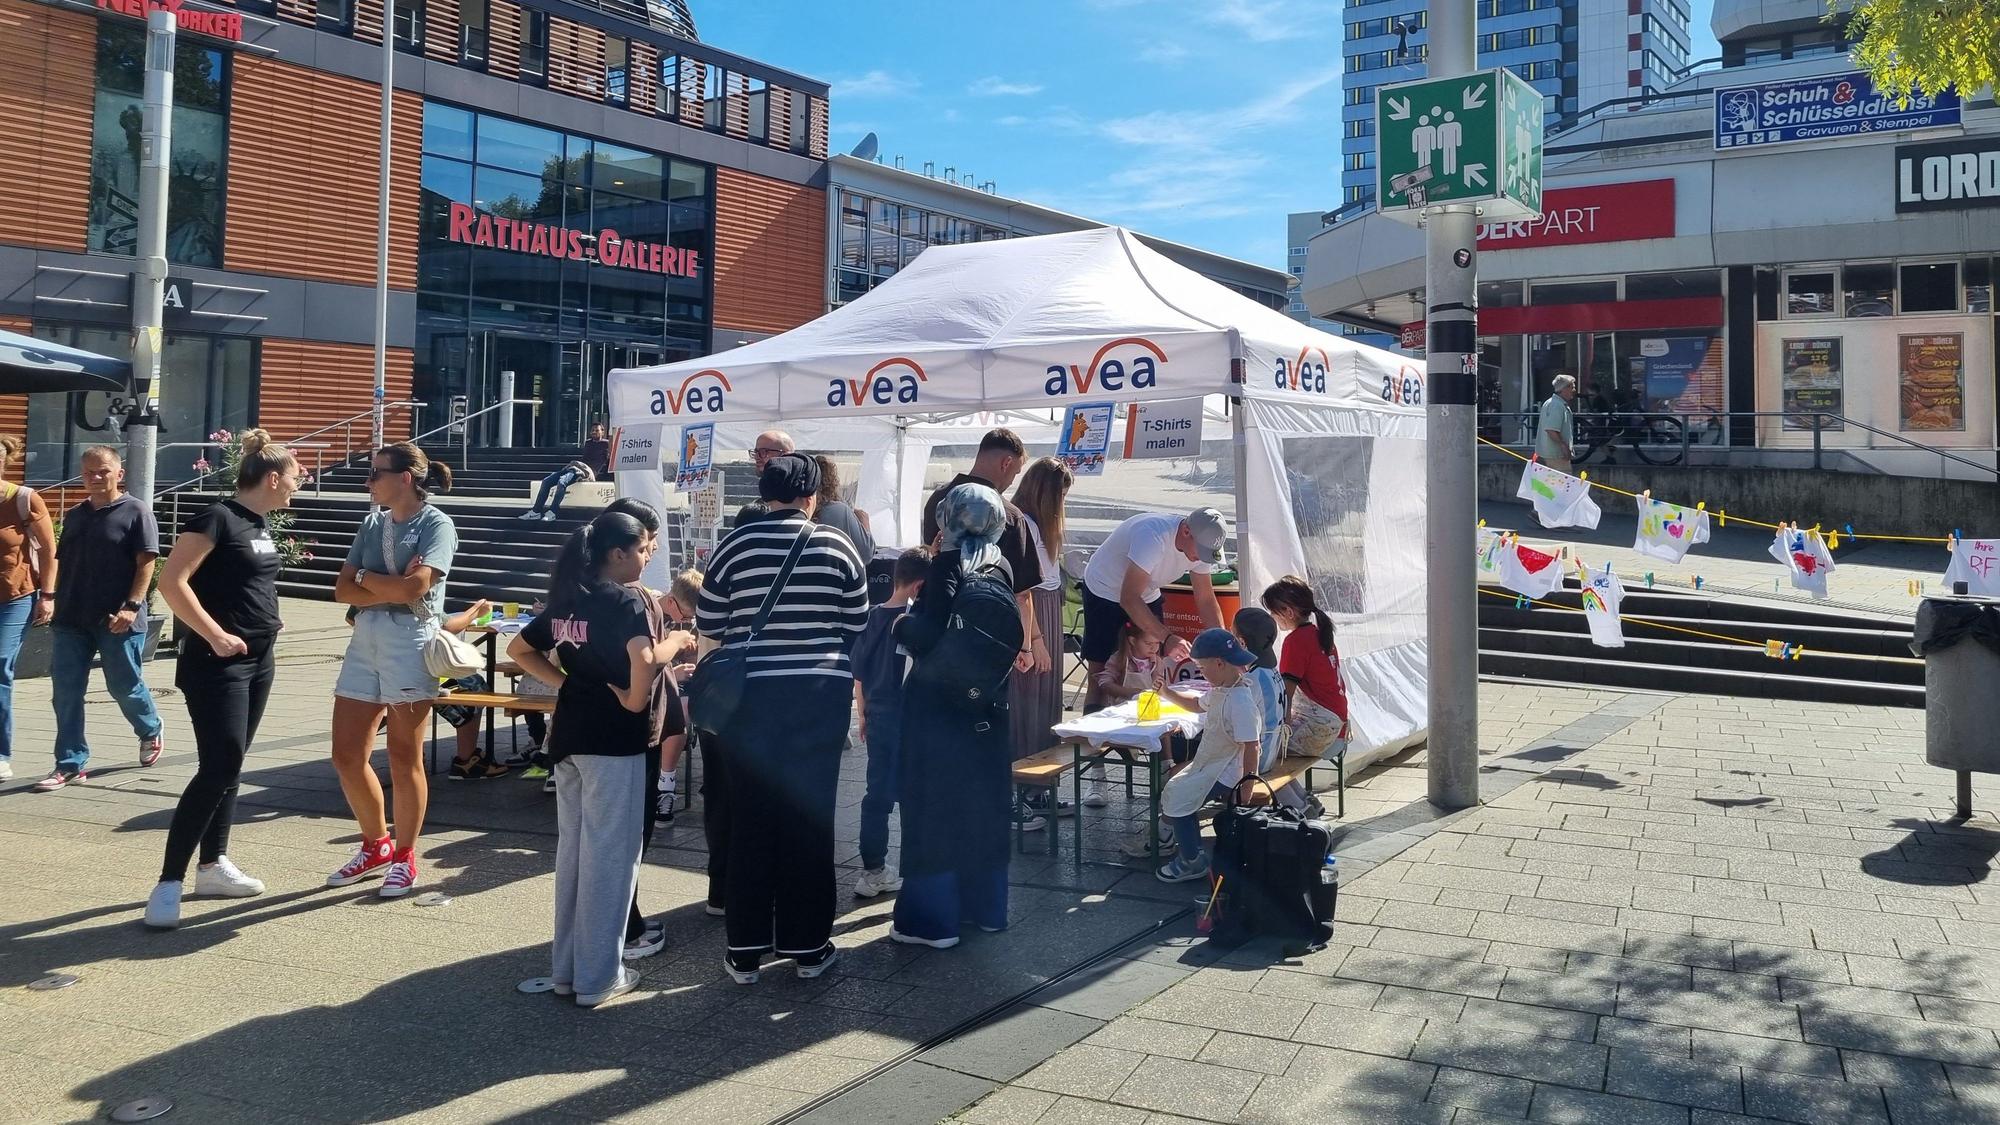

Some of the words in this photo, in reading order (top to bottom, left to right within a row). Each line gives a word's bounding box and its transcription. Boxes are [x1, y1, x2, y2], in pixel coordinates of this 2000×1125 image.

[1762, 86, 1829, 107] Schuh
[1832, 81, 1855, 105] &
[1796, 123, 1857, 138] Gravuren
[1860, 121, 1873, 133] &
[1875, 115, 1932, 131] Stempel
[450, 202, 699, 278] RATHAUS-GALERIE
[827, 358, 927, 407] avea
[1044, 338, 1168, 396] avea
[1275, 346, 1330, 393] avea
[650, 369, 732, 415] avea
[1382, 365, 1424, 405] avea
[1143, 418, 1191, 431] T-Shirts
[621, 439, 652, 449] T-Shirts
[622, 453, 647, 464] malen
[1146, 437, 1184, 449] malen
